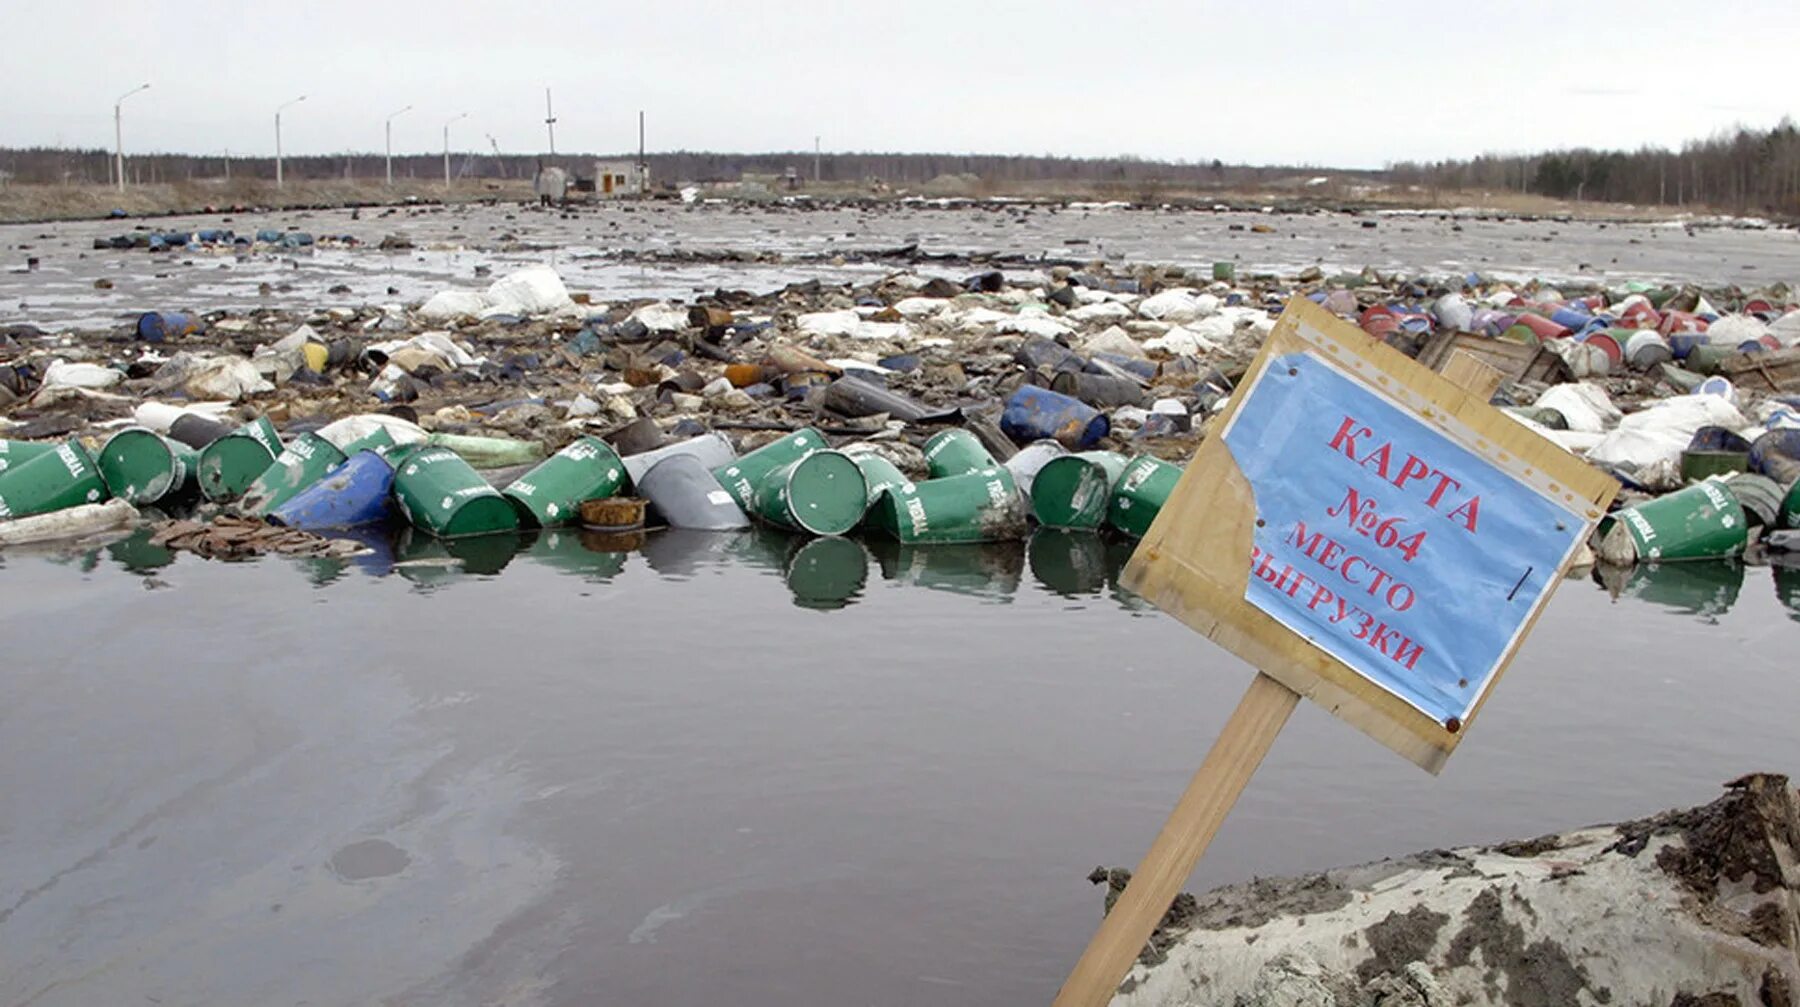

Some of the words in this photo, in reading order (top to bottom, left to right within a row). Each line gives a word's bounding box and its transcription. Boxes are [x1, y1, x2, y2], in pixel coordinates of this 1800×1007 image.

[1329, 416, 1481, 532] КАРТА
[1286, 522, 1415, 611] МЕСТО
[1328, 487, 1427, 561] №64
